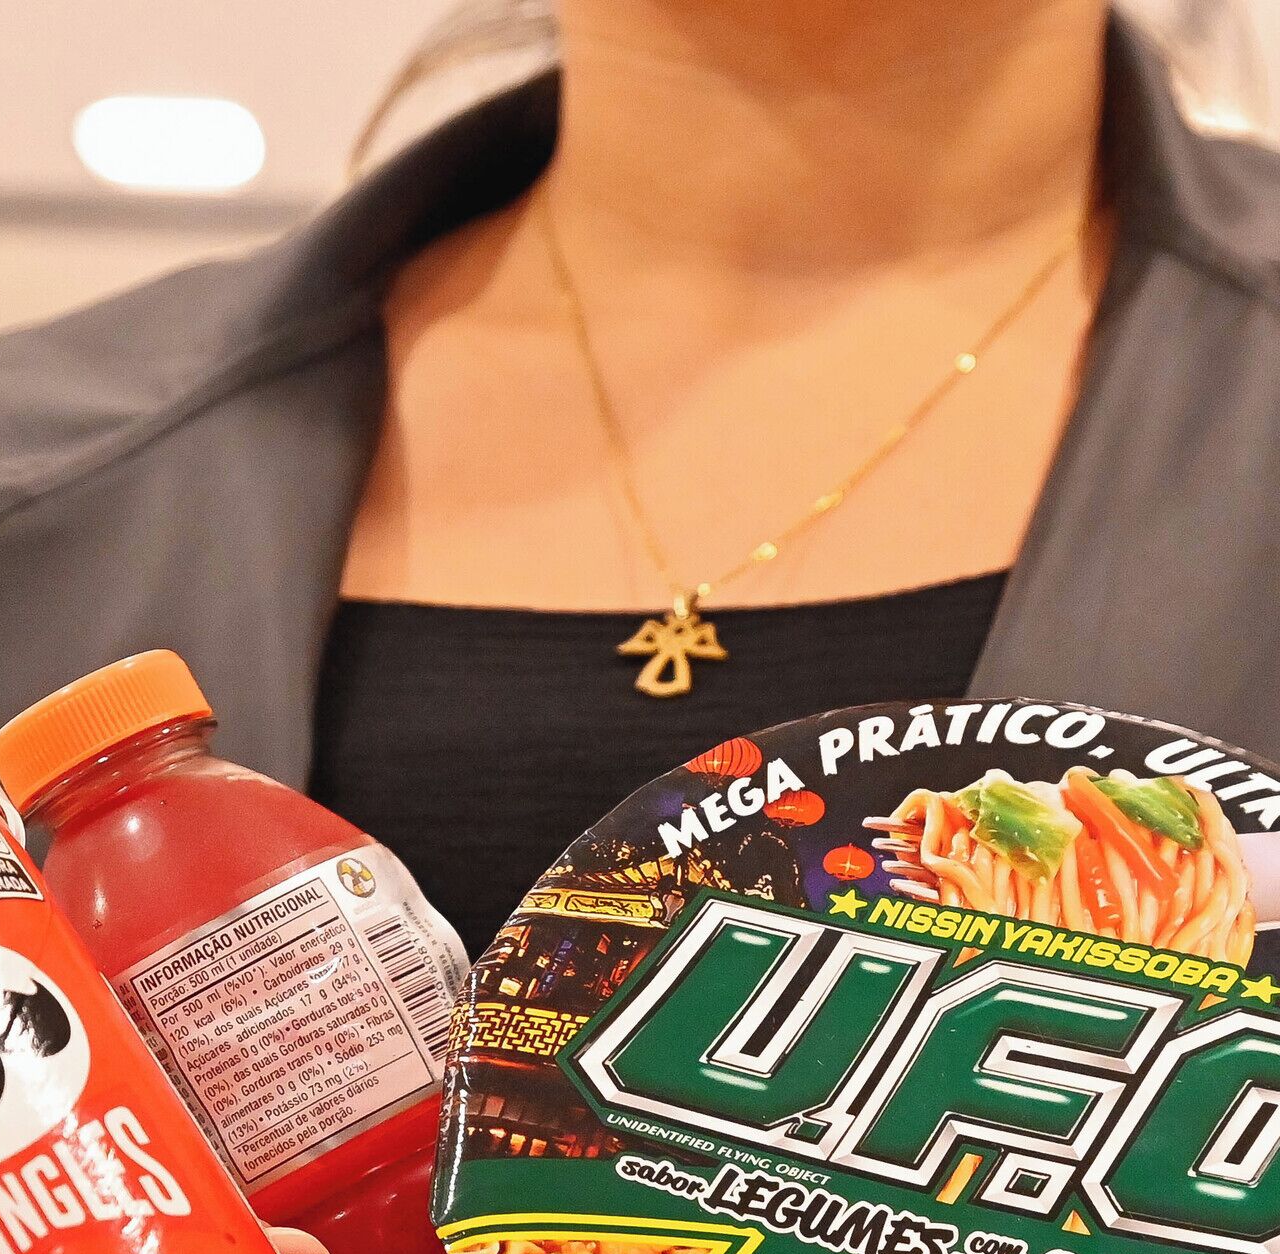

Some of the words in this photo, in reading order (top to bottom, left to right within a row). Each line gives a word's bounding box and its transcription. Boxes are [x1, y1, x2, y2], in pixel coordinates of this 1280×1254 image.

[656, 757, 806, 860] MEGA
[139, 932, 232, 993] INFORMAÇÃO
[232, 886, 323, 941] NUTRICIONAL
[149, 983, 189, 1010] Porção:
[187, 969, 209, 988] 500
[210, 961, 225, 976] ml
[224, 955, 237, 970] (1
[238, 931, 282, 961] unidade)
[159, 1012, 179, 1029] Por
[181, 998, 203, 1017] 500
[205, 987, 221, 1004] ml
[268, 948, 296, 968] Valor
[299, 923, 346, 953] energético
[867, 897, 1000, 946] NISSIN
[1001, 920, 1240, 994] YAKISSOBA
[168, 1024, 189, 1043] 120
[192, 1009, 216, 1029] kcal
[220, 993, 247, 1016] (6%)
[328, 940, 343, 955] 29
[185, 1040, 231, 1072] Açúcares
[235, 1005, 295, 1043] adicionados
[299, 992, 312, 1007] 17
[330, 969, 361, 993] (34%)
[213, 1021, 233, 1036] dos
[234, 1005, 263, 1025] quais
[263, 979, 309, 1010] Açúcares
[193, 1053, 241, 1086] Proteínas
[258, 1028, 285, 1051] (0%)
[290, 1001, 337, 1031] Gorduras
[220, 1091, 274, 1129] alimentares
[297, 1062, 325, 1085] (0%)
[333, 1042, 364, 1064] Sódio
[365, 1030, 385, 1047] 253
[386, 1023, 403, 1036] mg
[232, 1066, 251, 1083] das
[251, 1051, 279, 1072] quais
[278, 1026, 325, 1056] Gorduras
[325, 1002, 371, 1031] saturadas
[240, 1066, 286, 1097] Gorduras
[286, 1051, 314, 1071] trans
[333, 1025, 360, 1048] (0%)
[364, 1008, 395, 1029] Fibras
[227, 1118, 259, 1144] (13%)
[263, 1091, 308, 1121] Potássio
[307, 1081, 323, 1096] 73
[323, 1073, 343, 1088] mg
[243, 1137, 296, 1172] fornecidos
[295, 1124, 318, 1145] pela
[317, 1105, 356, 1132] porção.
[294, 1113, 309, 1126] de
[308, 1093, 346, 1117] valores
[345, 1075, 379, 1098] diários
[606, 1113, 715, 1153] UNIDENTIFIED
[718, 1146, 772, 1169] FLYING
[775, 1163, 832, 1185] OBJECT
[619, 1157, 708, 1198] sabor
